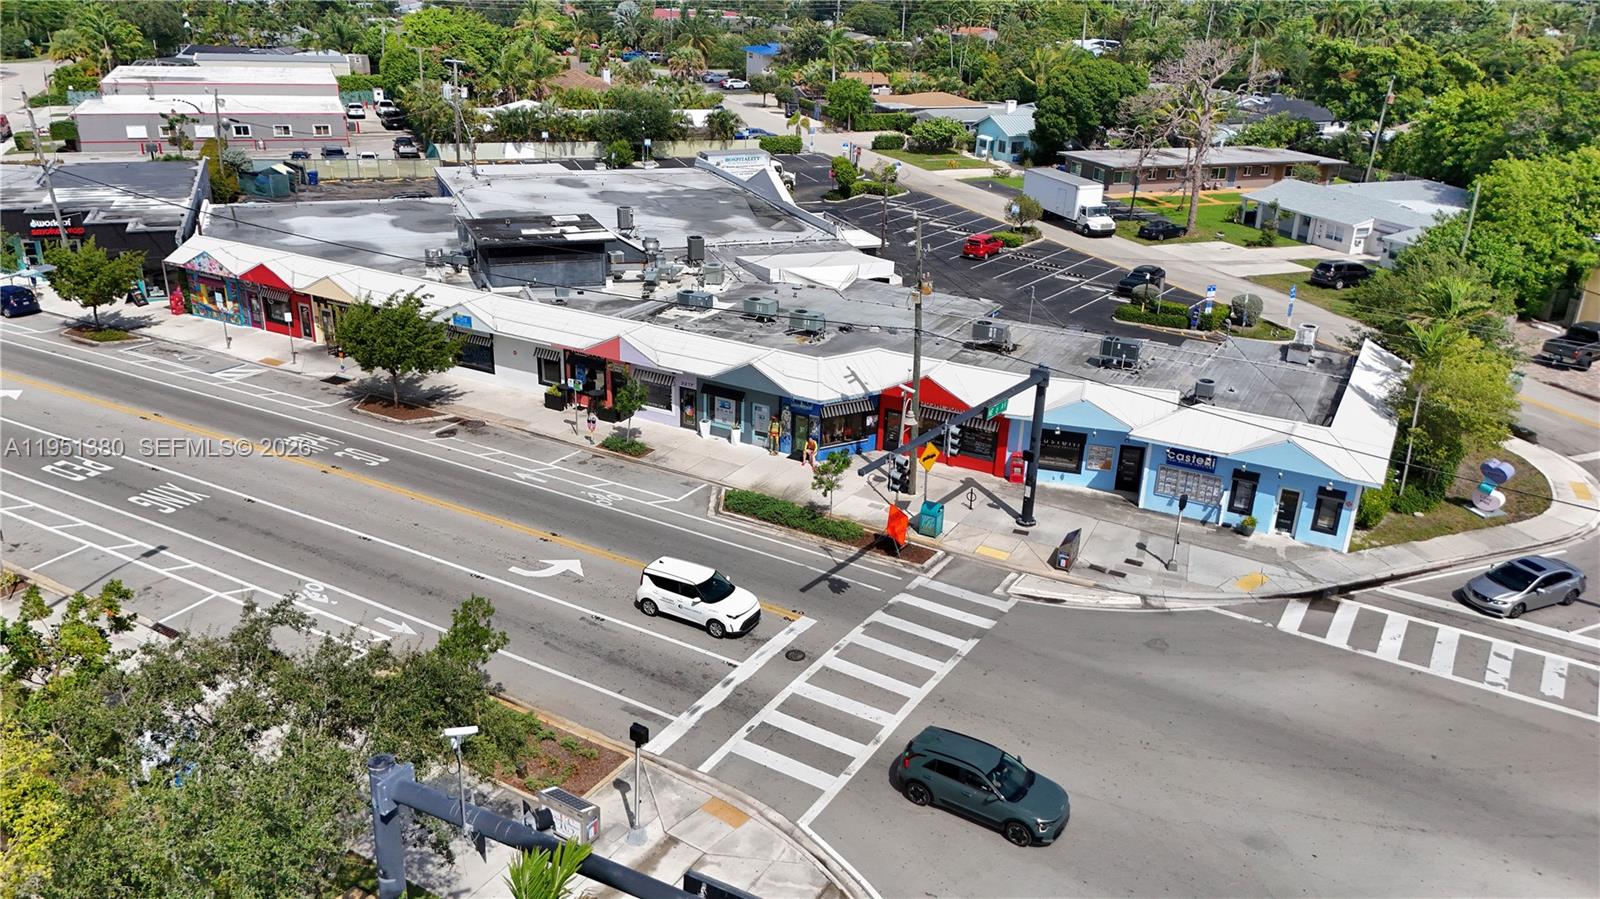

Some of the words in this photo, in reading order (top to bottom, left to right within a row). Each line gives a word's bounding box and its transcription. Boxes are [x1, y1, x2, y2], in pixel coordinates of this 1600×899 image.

[63, 217, 72, 226] of
[334, 447, 390, 466] 30
[41, 455, 114, 481] PED
[127, 482, 211, 514] XING
